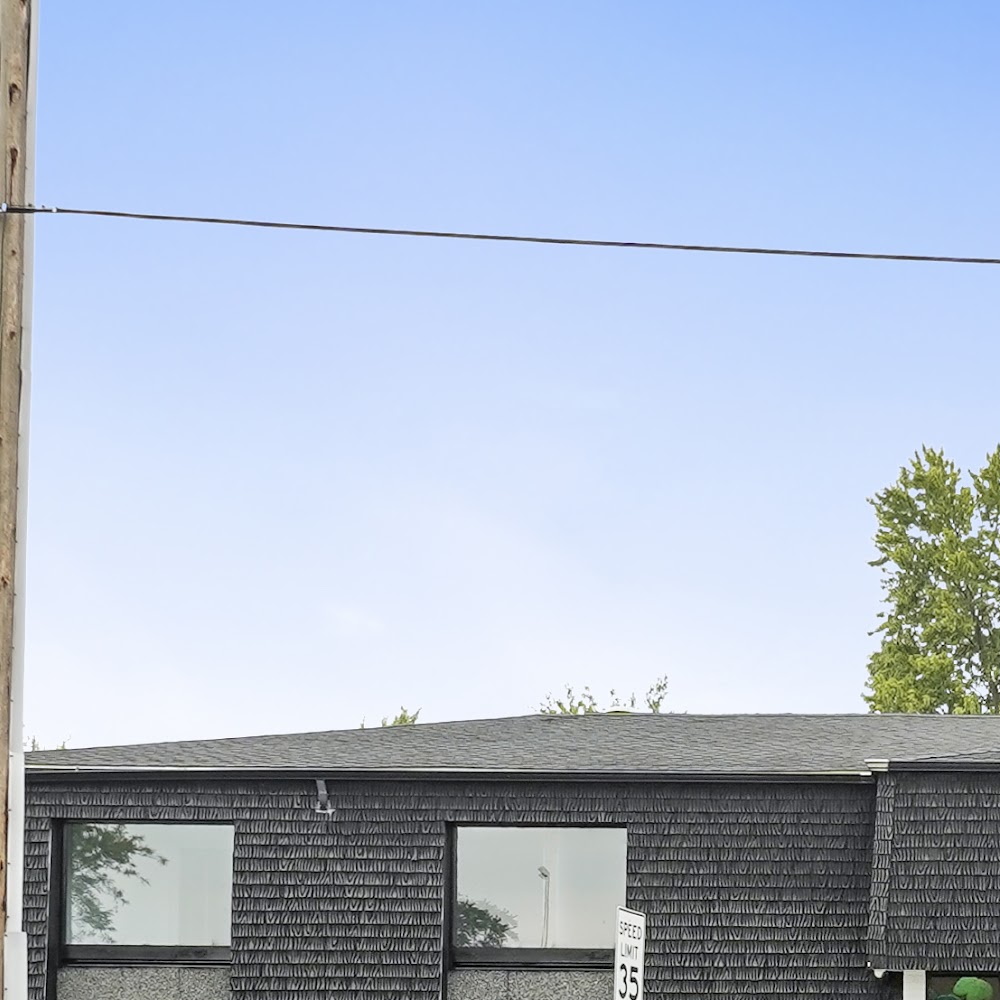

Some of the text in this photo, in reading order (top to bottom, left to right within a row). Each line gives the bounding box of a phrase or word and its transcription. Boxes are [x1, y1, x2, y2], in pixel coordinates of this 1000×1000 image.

[619, 921, 642, 940] SPEED
[620, 942, 638, 960] LIMIT
[619, 963, 639, 1000] 35
